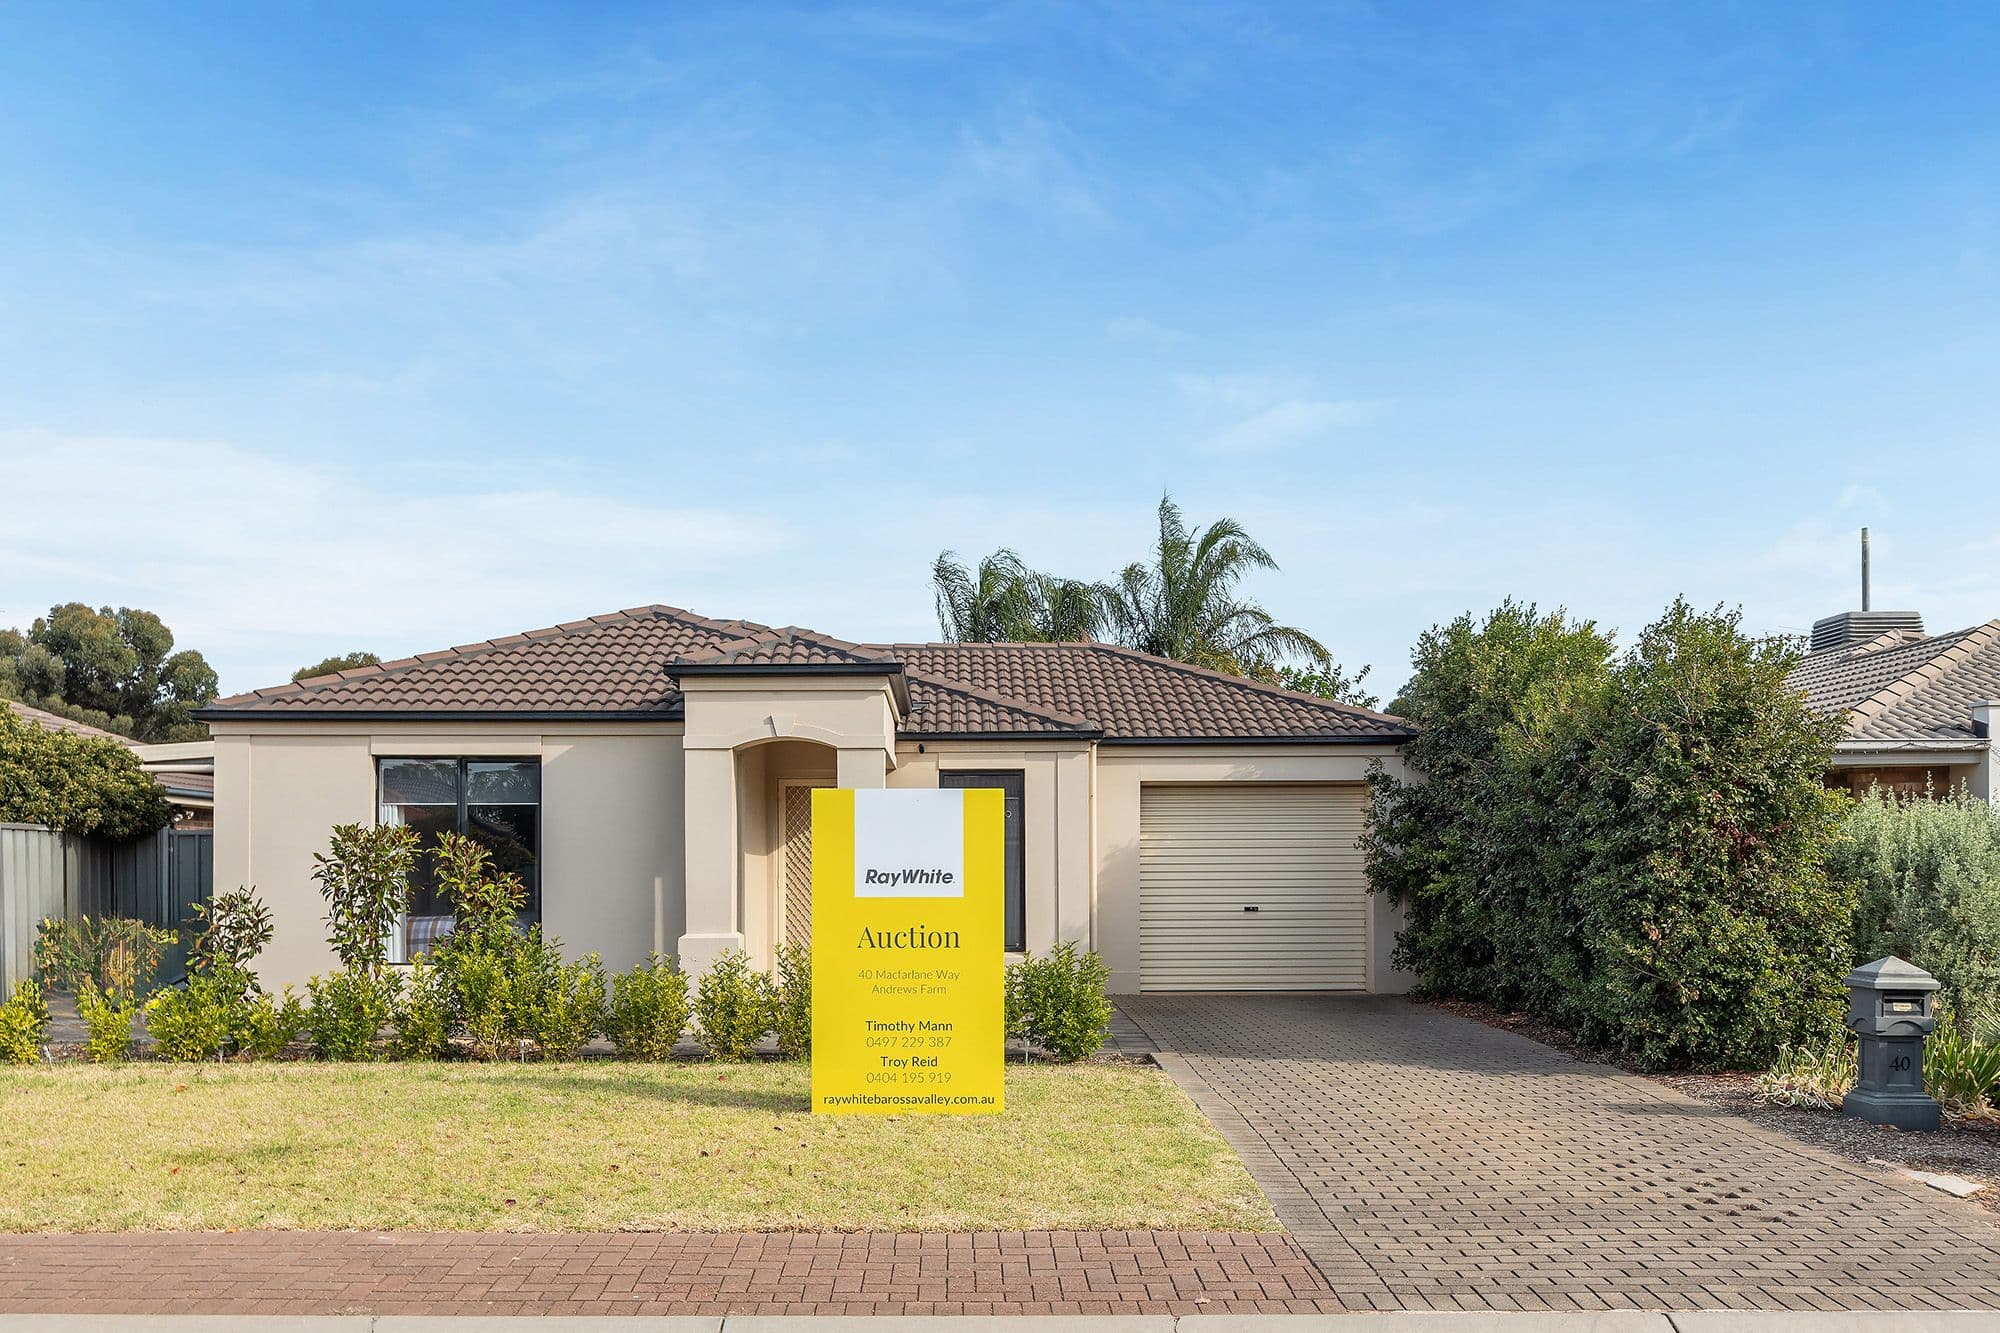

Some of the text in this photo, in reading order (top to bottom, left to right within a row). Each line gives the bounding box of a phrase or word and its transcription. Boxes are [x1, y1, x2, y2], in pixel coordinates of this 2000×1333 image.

[857, 925, 960, 949] Auction
[858, 969, 960, 982] 40 Macfarlane Way
[871, 984, 947, 994] Andrews Farm
[865, 1020, 953, 1033] Timothy Mann
[866, 1036, 952, 1048] 0497 229 387
[880, 1056, 938, 1069] Troy Reid
[1888, 1055, 1911, 1072] 40
[866, 1072, 952, 1084] 0404 195 919
[823, 1093, 995, 1107] raywhitebarossavalley.com.au
